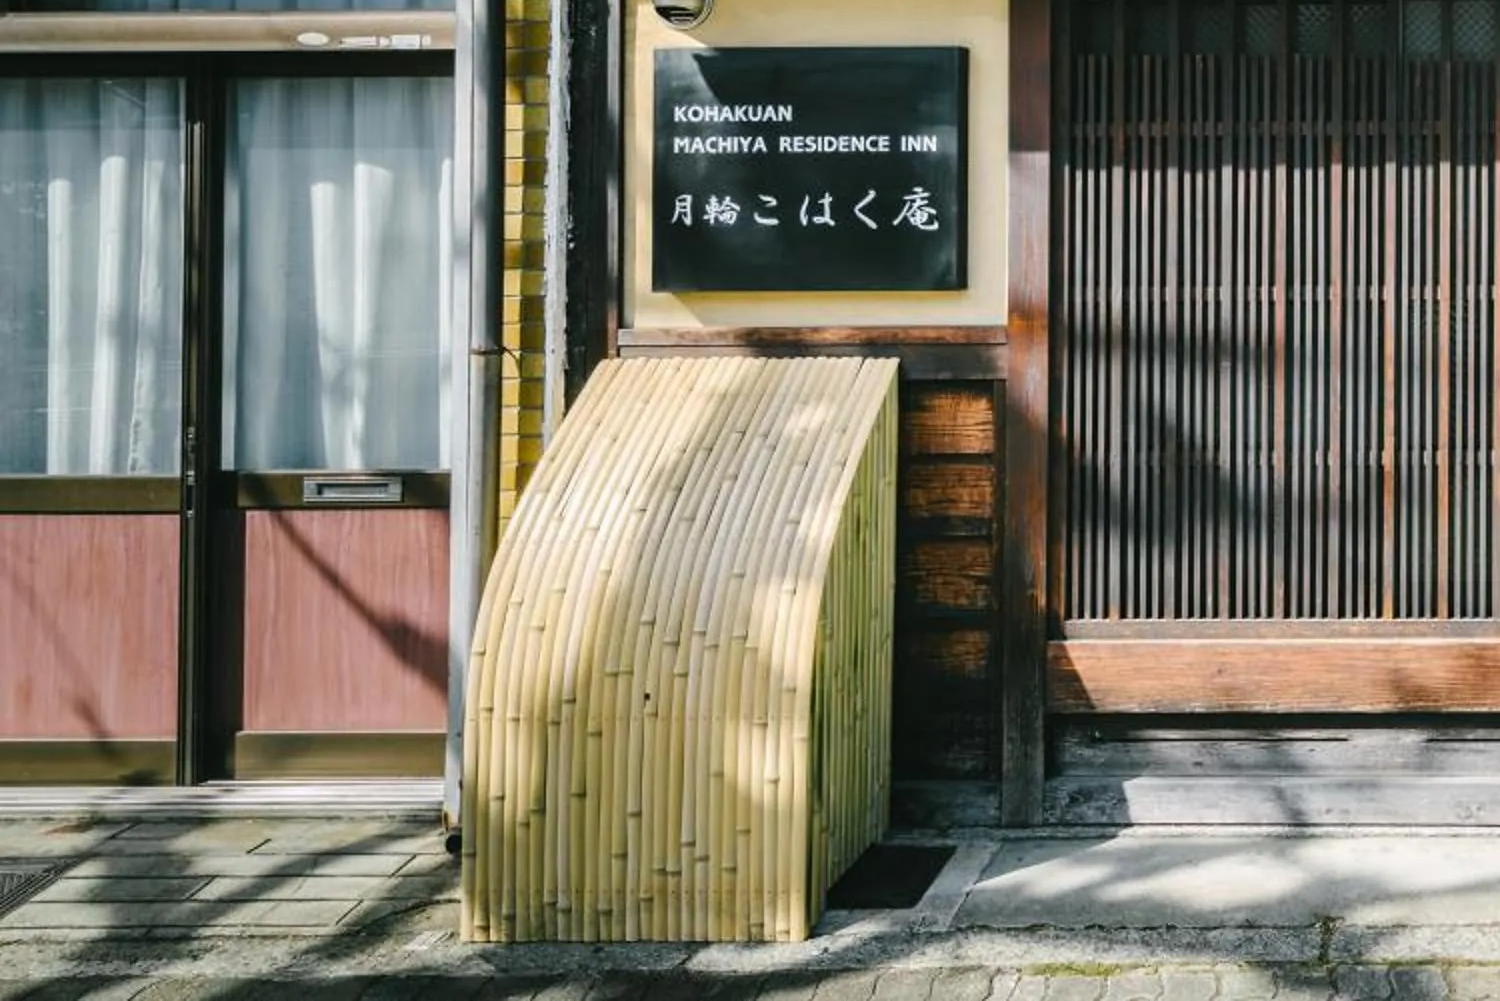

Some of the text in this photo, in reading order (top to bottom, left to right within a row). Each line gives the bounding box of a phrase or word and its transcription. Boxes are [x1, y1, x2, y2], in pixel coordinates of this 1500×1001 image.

[673, 105, 793, 123] KOHAKUAN
[673, 135, 938, 154] MACHIYA RESIDENCE INN
